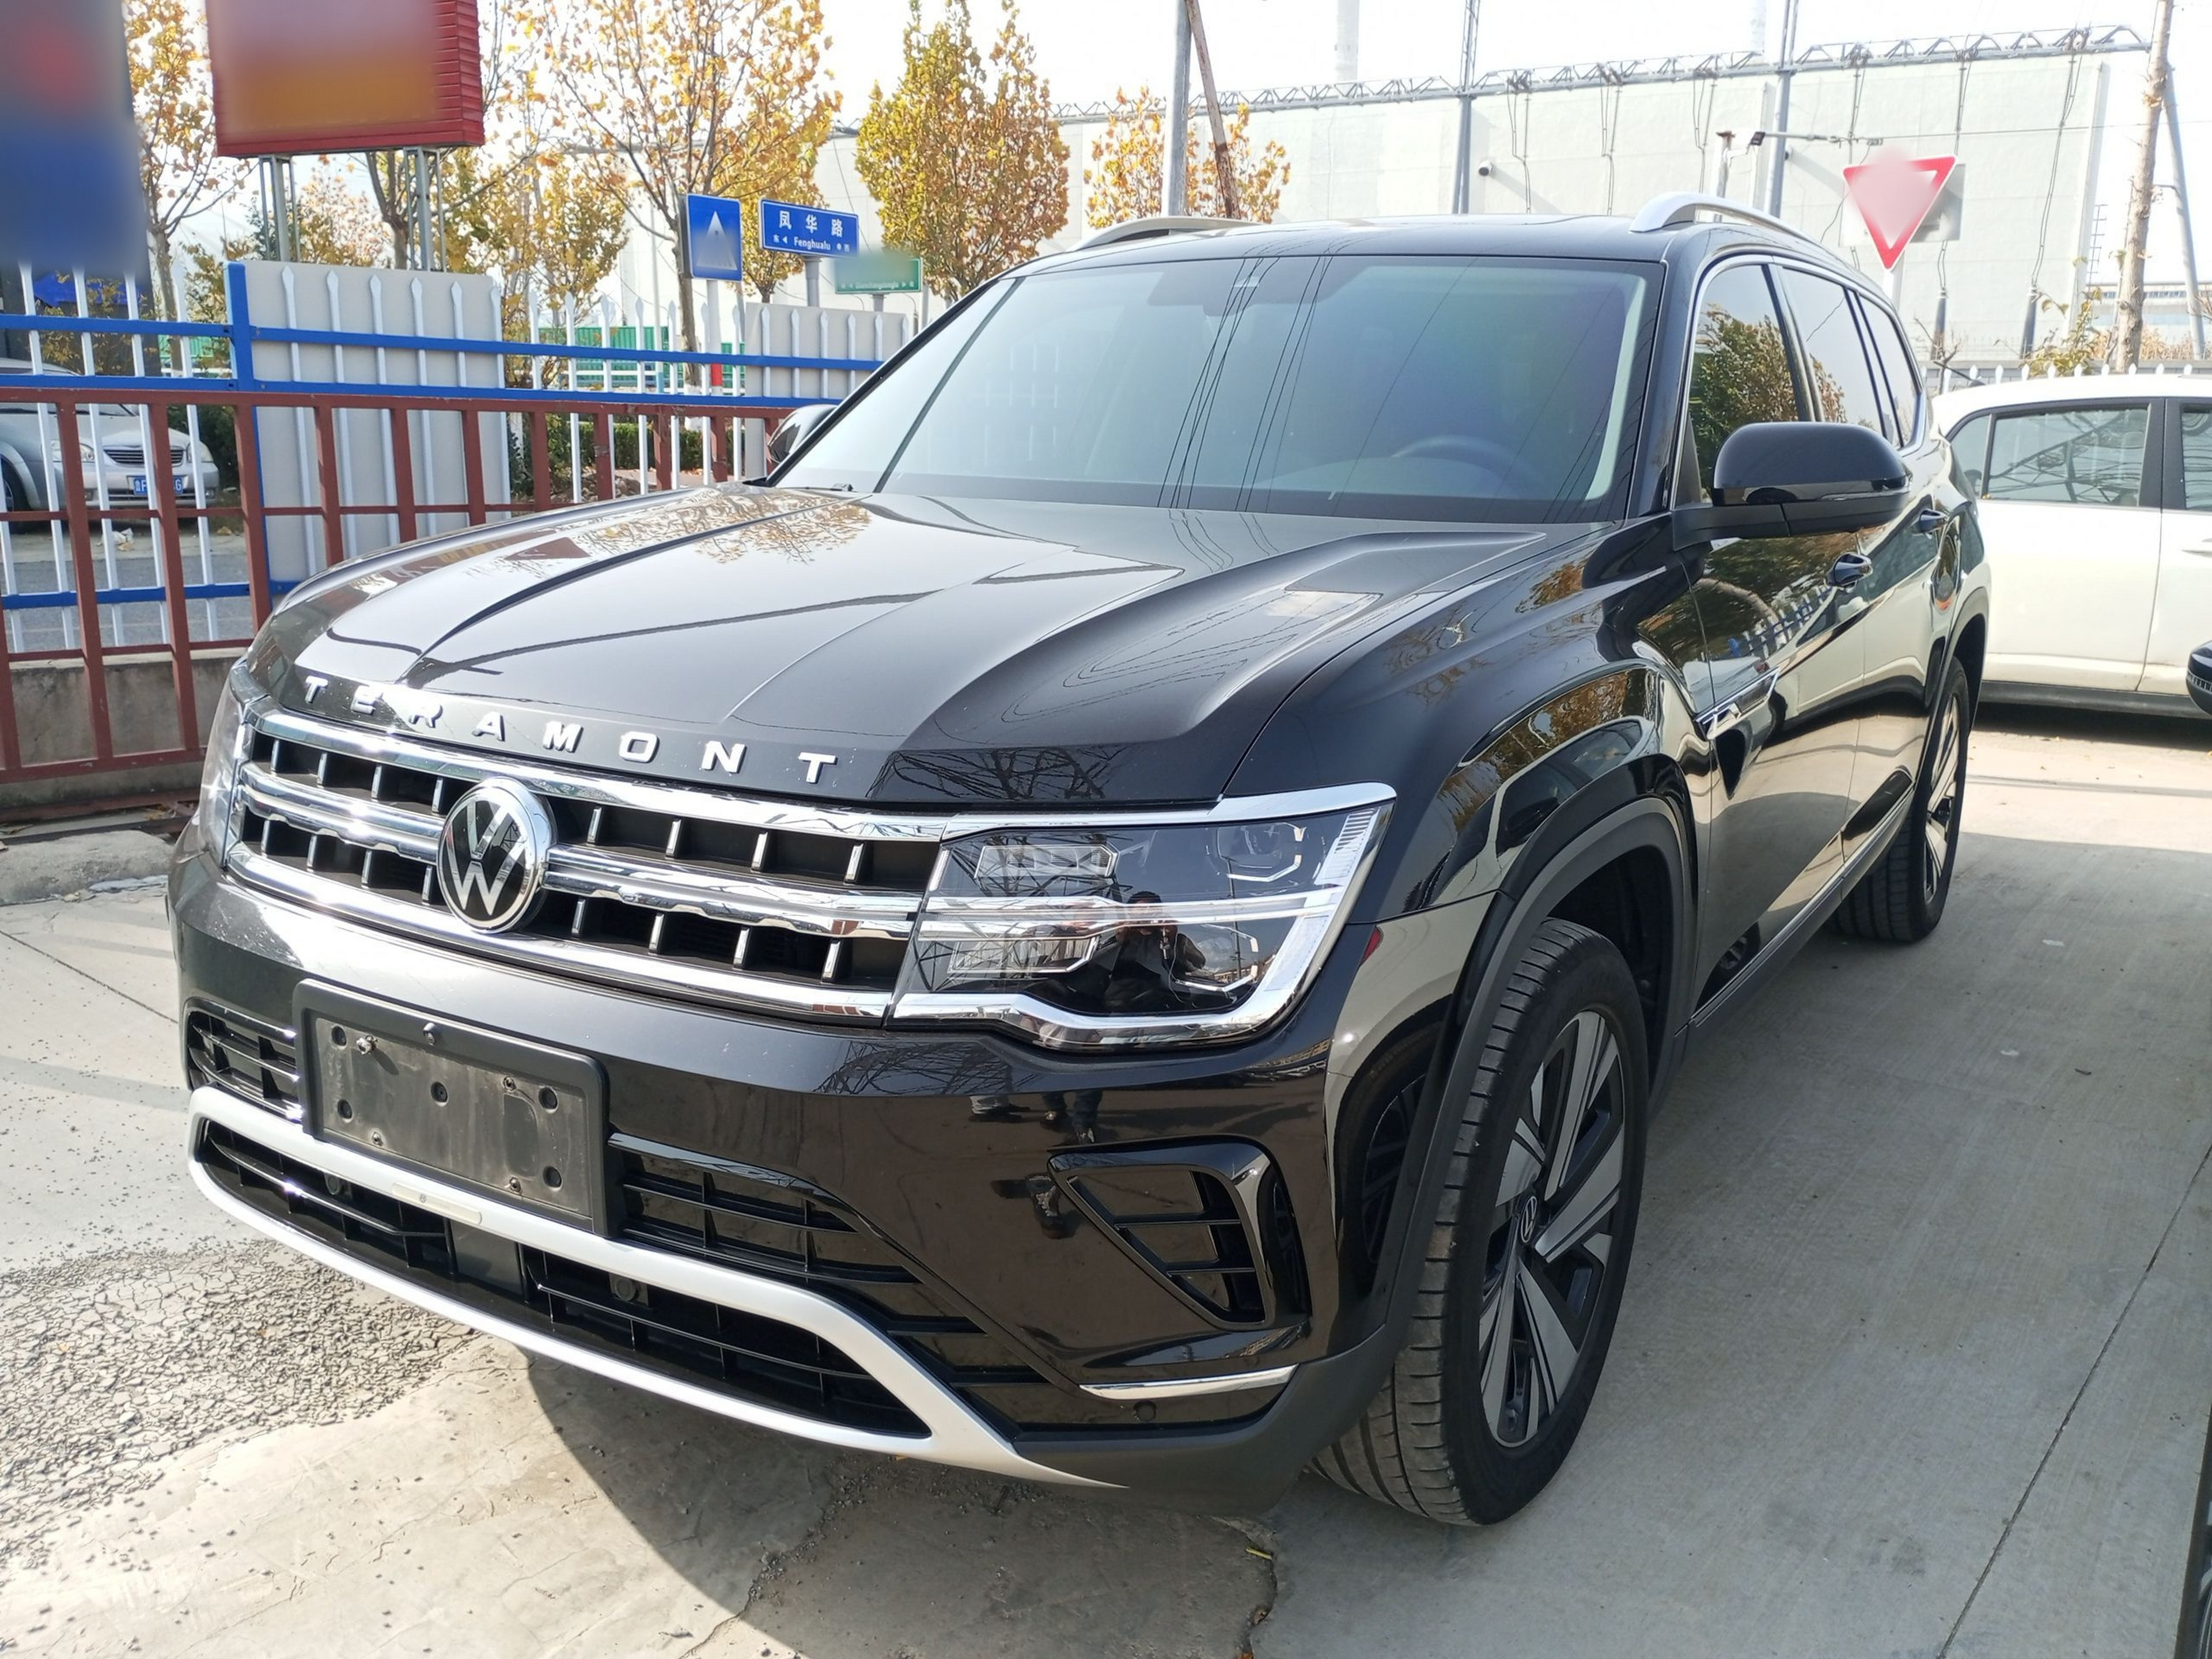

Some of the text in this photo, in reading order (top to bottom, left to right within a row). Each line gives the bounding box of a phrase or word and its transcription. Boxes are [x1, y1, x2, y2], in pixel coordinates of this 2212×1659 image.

[779, 210, 843, 237] 凤华路
[794, 236, 831, 250] Fenghualu
[304, 676, 836, 783] TERAMONT
[440, 787, 536, 929] VW
